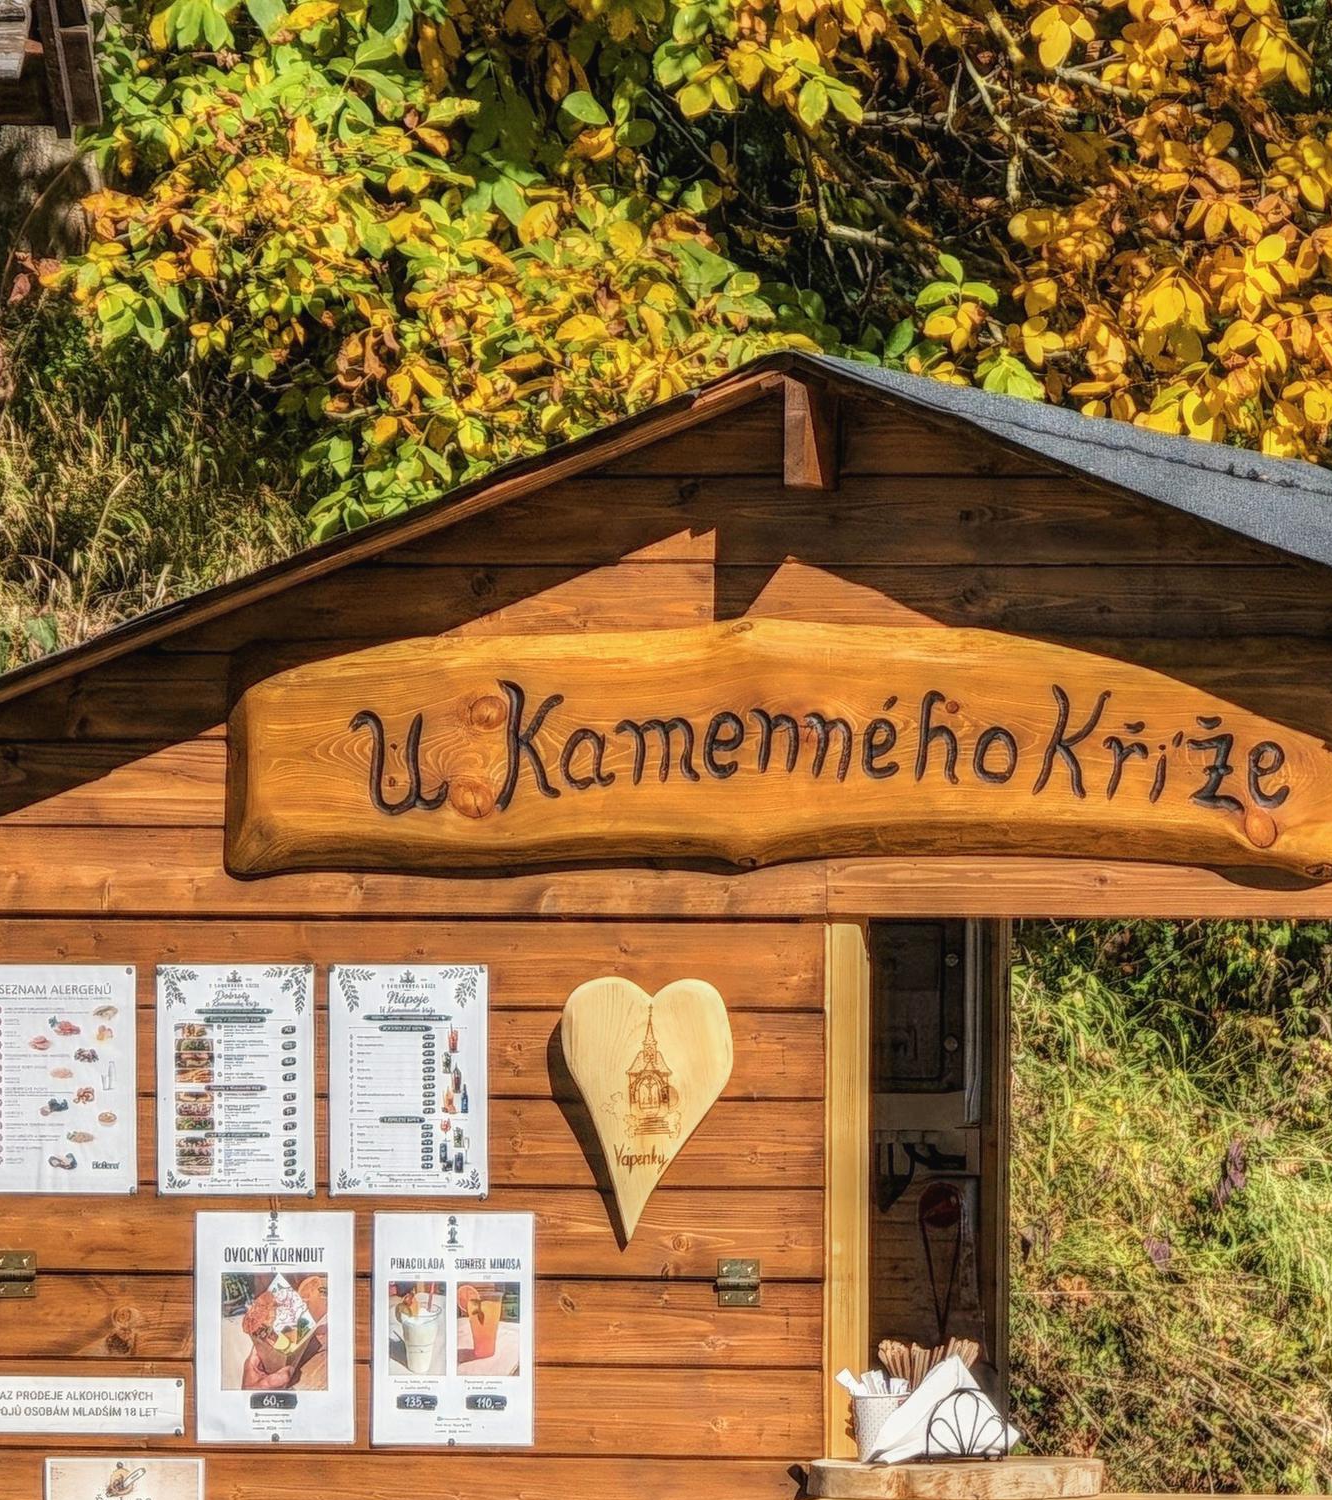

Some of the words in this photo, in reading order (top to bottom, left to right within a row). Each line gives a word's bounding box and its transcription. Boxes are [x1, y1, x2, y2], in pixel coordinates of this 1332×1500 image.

[348, 708, 449, 816] U
[494, 678, 1017, 812] Kamenného
[1032, 684, 1291, 812] Kříže
[51, 982, 112, 995] ALERGENŮ
[387, 991, 430, 1007] Nápoje
[224, 1244, 269, 1263] OVOCNÝ
[272, 1247, 325, 1263] KORNOUT
[489, 1258, 521, 1271] MIMOSA
[16, 1391, 63, 1401] PRODEJE
[66, 1389, 153, 1401] ALKOHOLICKÝCH
[24, 1405, 69, 1416] OSOBÁM
[72, 1405, 121, 1417] MLADŠÍM
[124, 1407, 136, 1417] 18
[139, 1407, 158, 1417] LET
